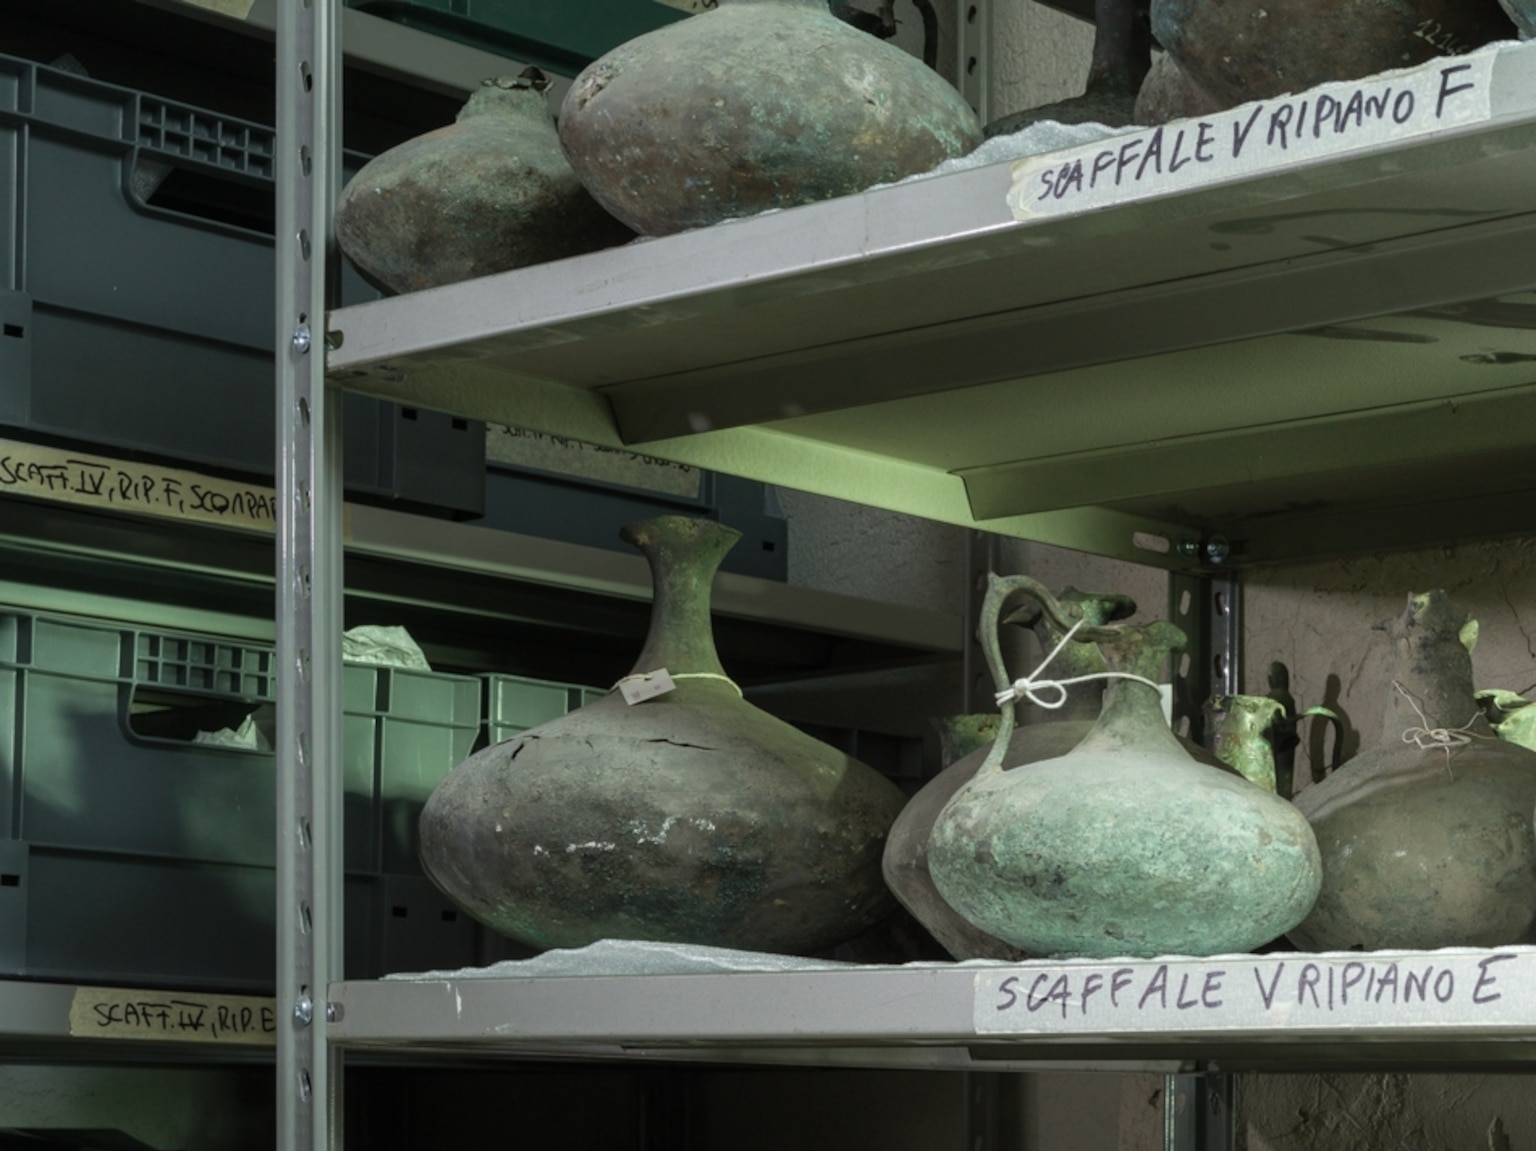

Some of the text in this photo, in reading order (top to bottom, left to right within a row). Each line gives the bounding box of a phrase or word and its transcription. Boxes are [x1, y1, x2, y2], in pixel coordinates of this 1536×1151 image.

[1039, 64, 1474, 200] SCAFFALE V RIPIANO F
[997, 955, 1517, 1018] SCAFFALE V RIPIANO E
